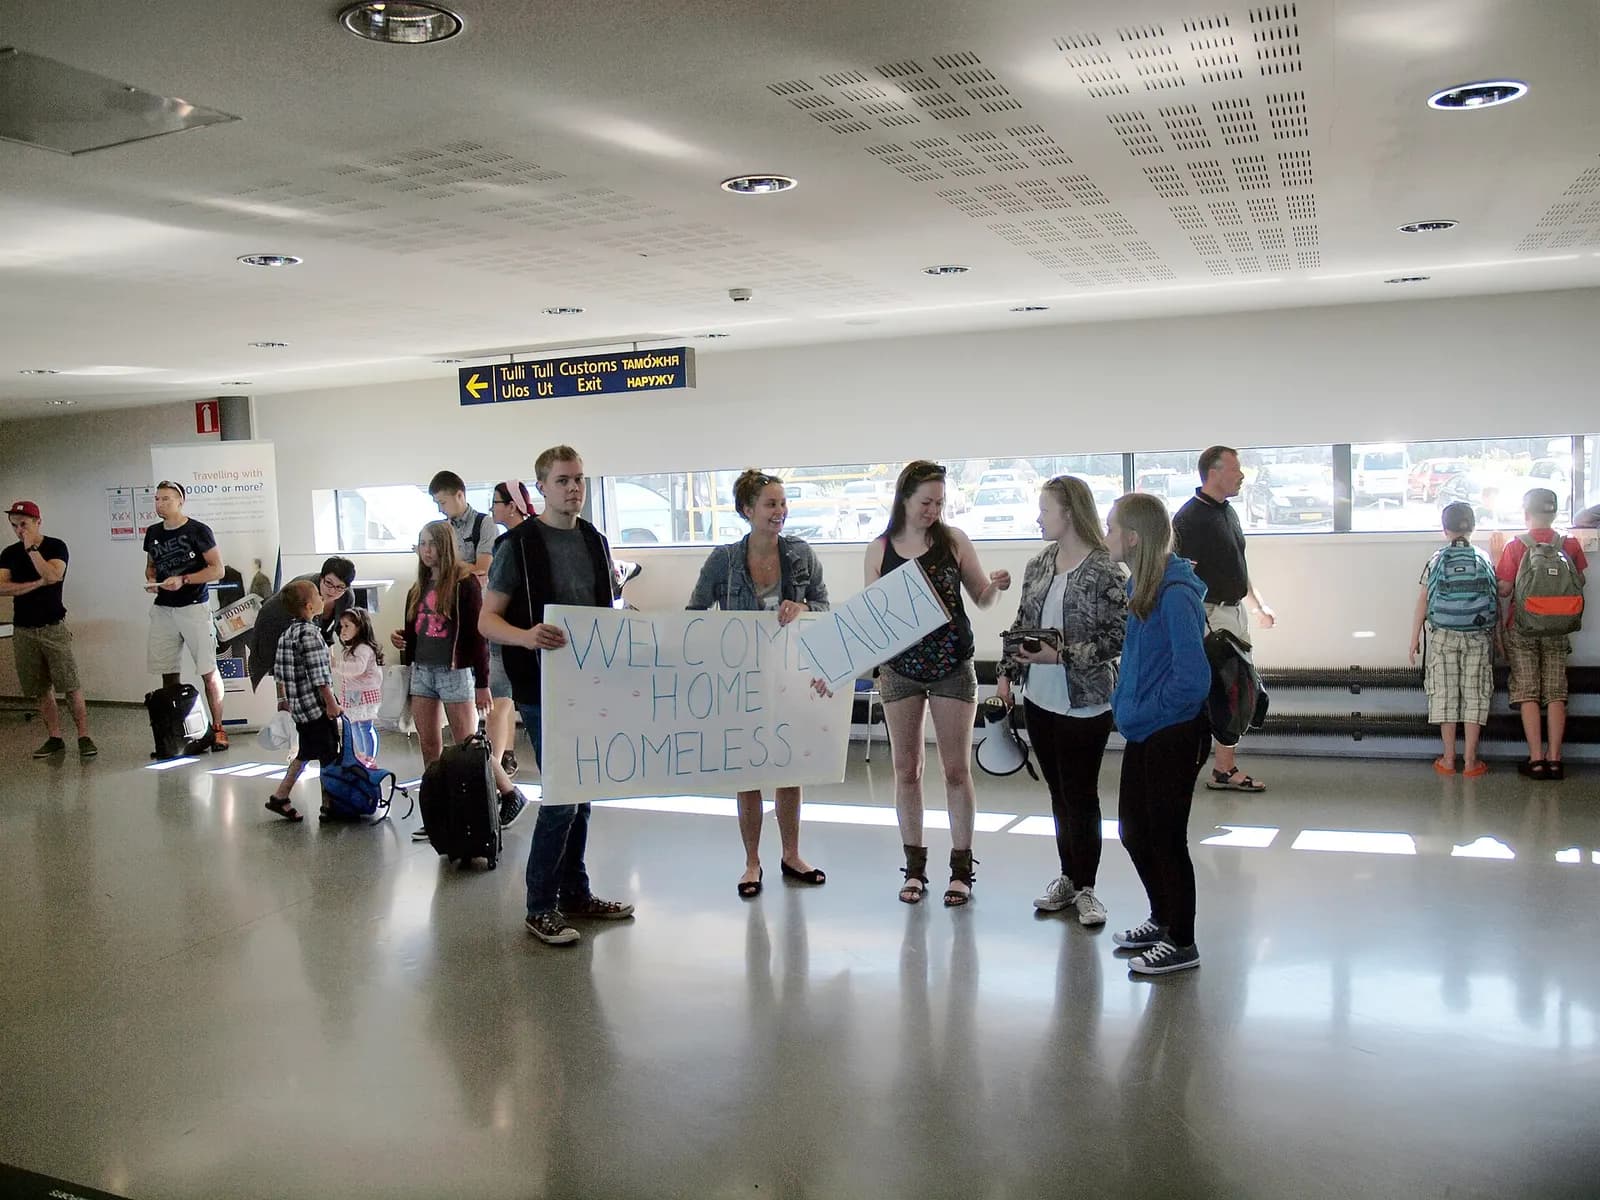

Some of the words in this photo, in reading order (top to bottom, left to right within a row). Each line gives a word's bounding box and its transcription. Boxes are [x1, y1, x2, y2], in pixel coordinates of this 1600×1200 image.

[500, 366, 525, 381] Tulli
[532, 363, 554, 377] Tull
[560, 359, 617, 376] Customs
[501, 383, 530, 398] Ulos
[537, 382, 554, 396] Ut
[578, 377, 602, 392] Exit
[627, 374, 675, 388] НАРУЖУ
[193, 470, 239, 481] Travelling
[241, 468, 263, 479] with
[234, 482, 264, 492] more?
[801, 569, 940, 683] LAURA
[652, 670, 763, 721] HOME
[576, 723, 792, 785] HOMELESS
